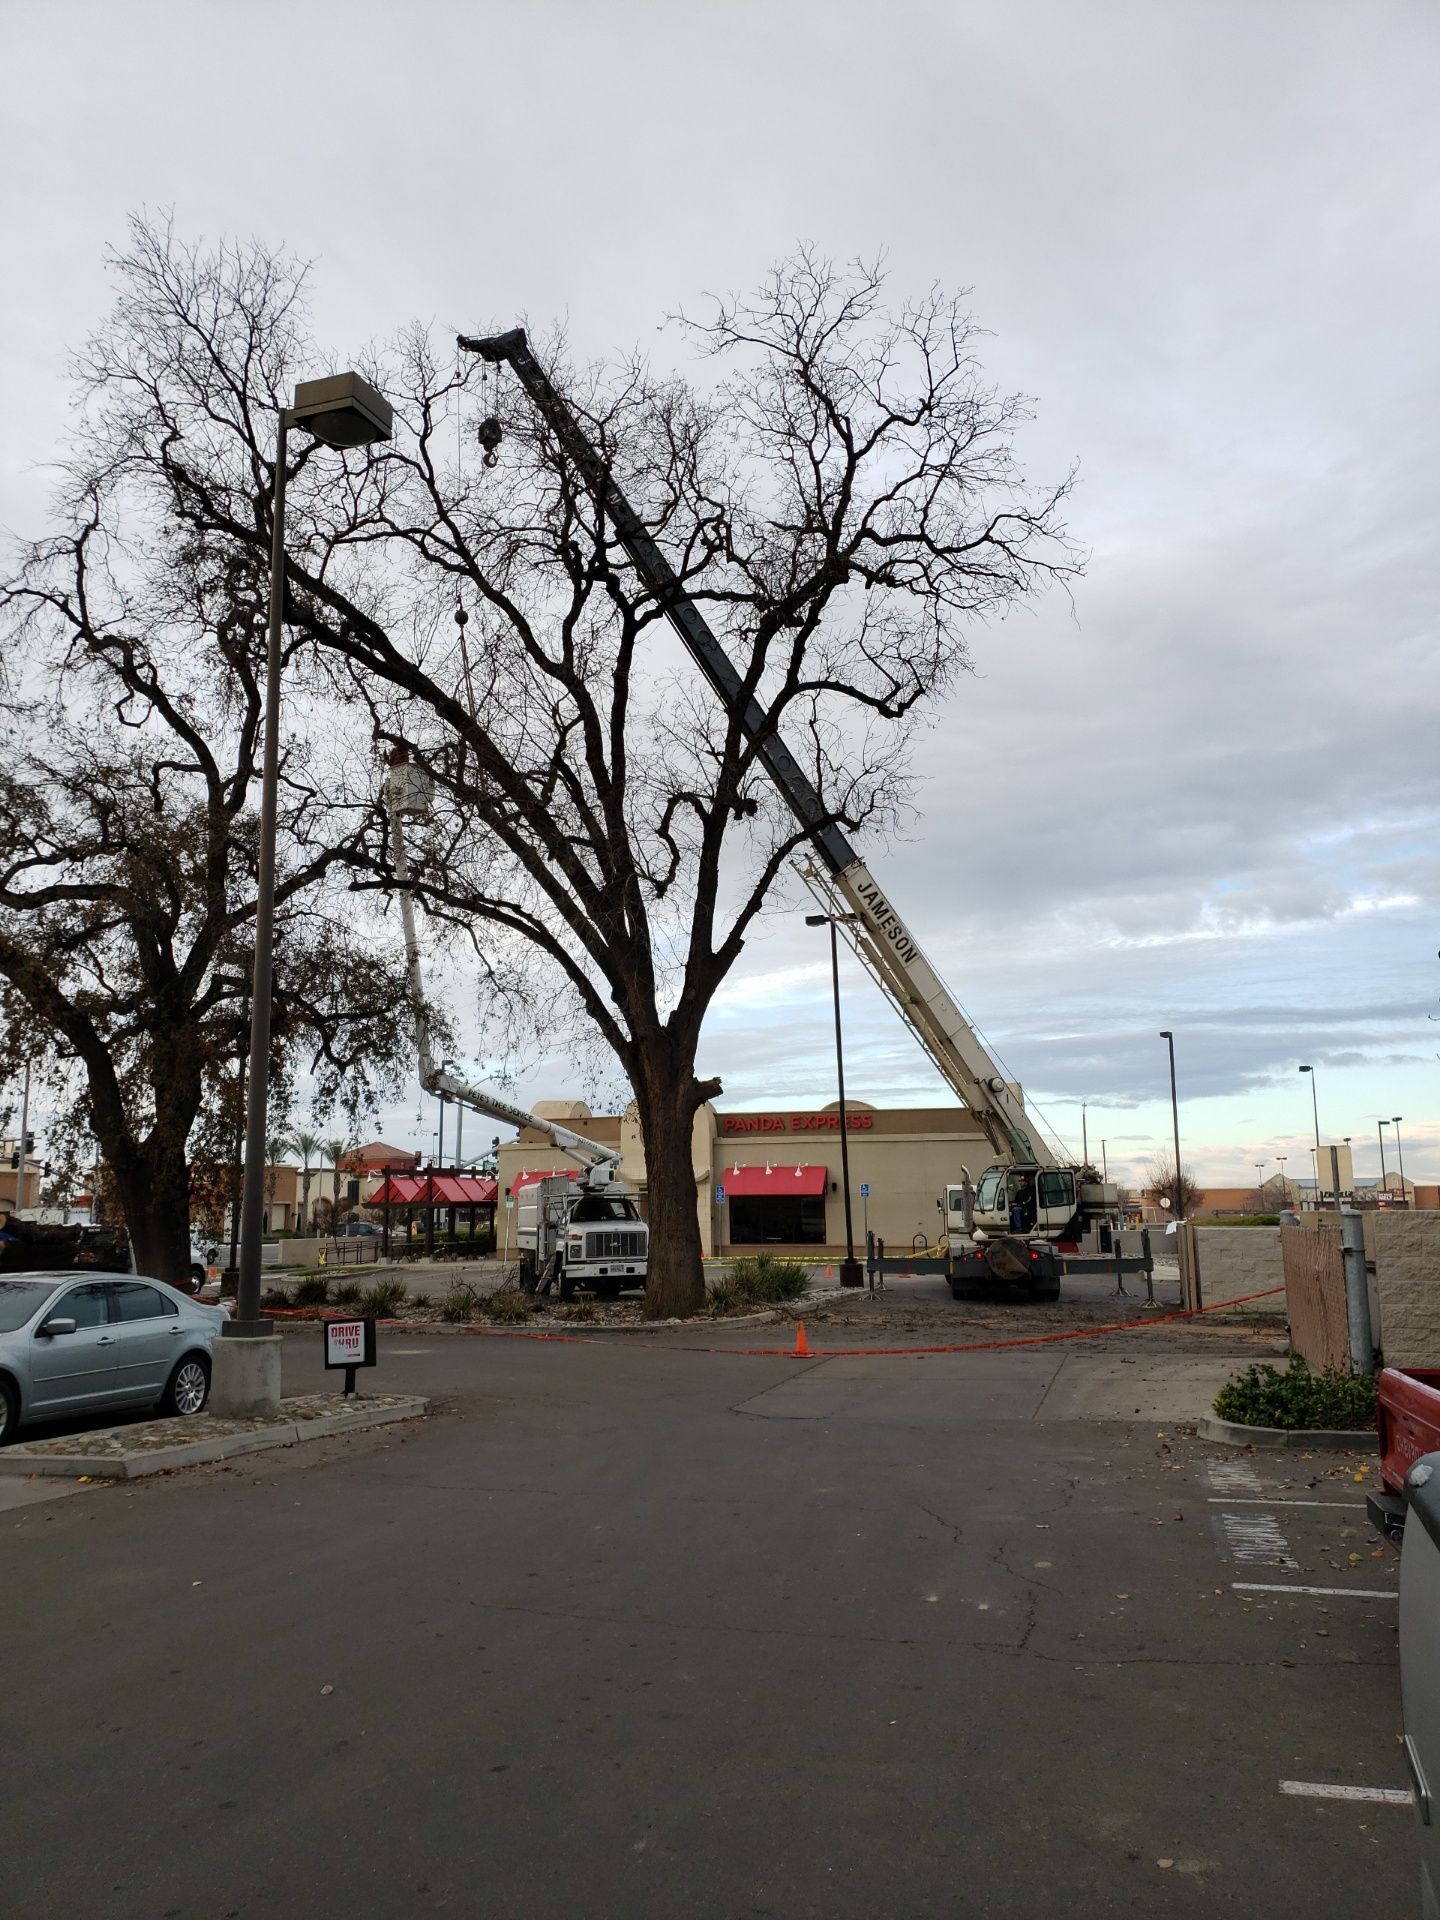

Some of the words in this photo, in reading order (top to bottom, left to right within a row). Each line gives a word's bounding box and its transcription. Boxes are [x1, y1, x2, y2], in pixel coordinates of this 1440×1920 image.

[858, 884, 917, 963] JAMESON
[492, 1098, 507, 1111] TREE
[724, 1117, 784, 1131] PANDA
[331, 1325, 360, 1337] DRIVE
